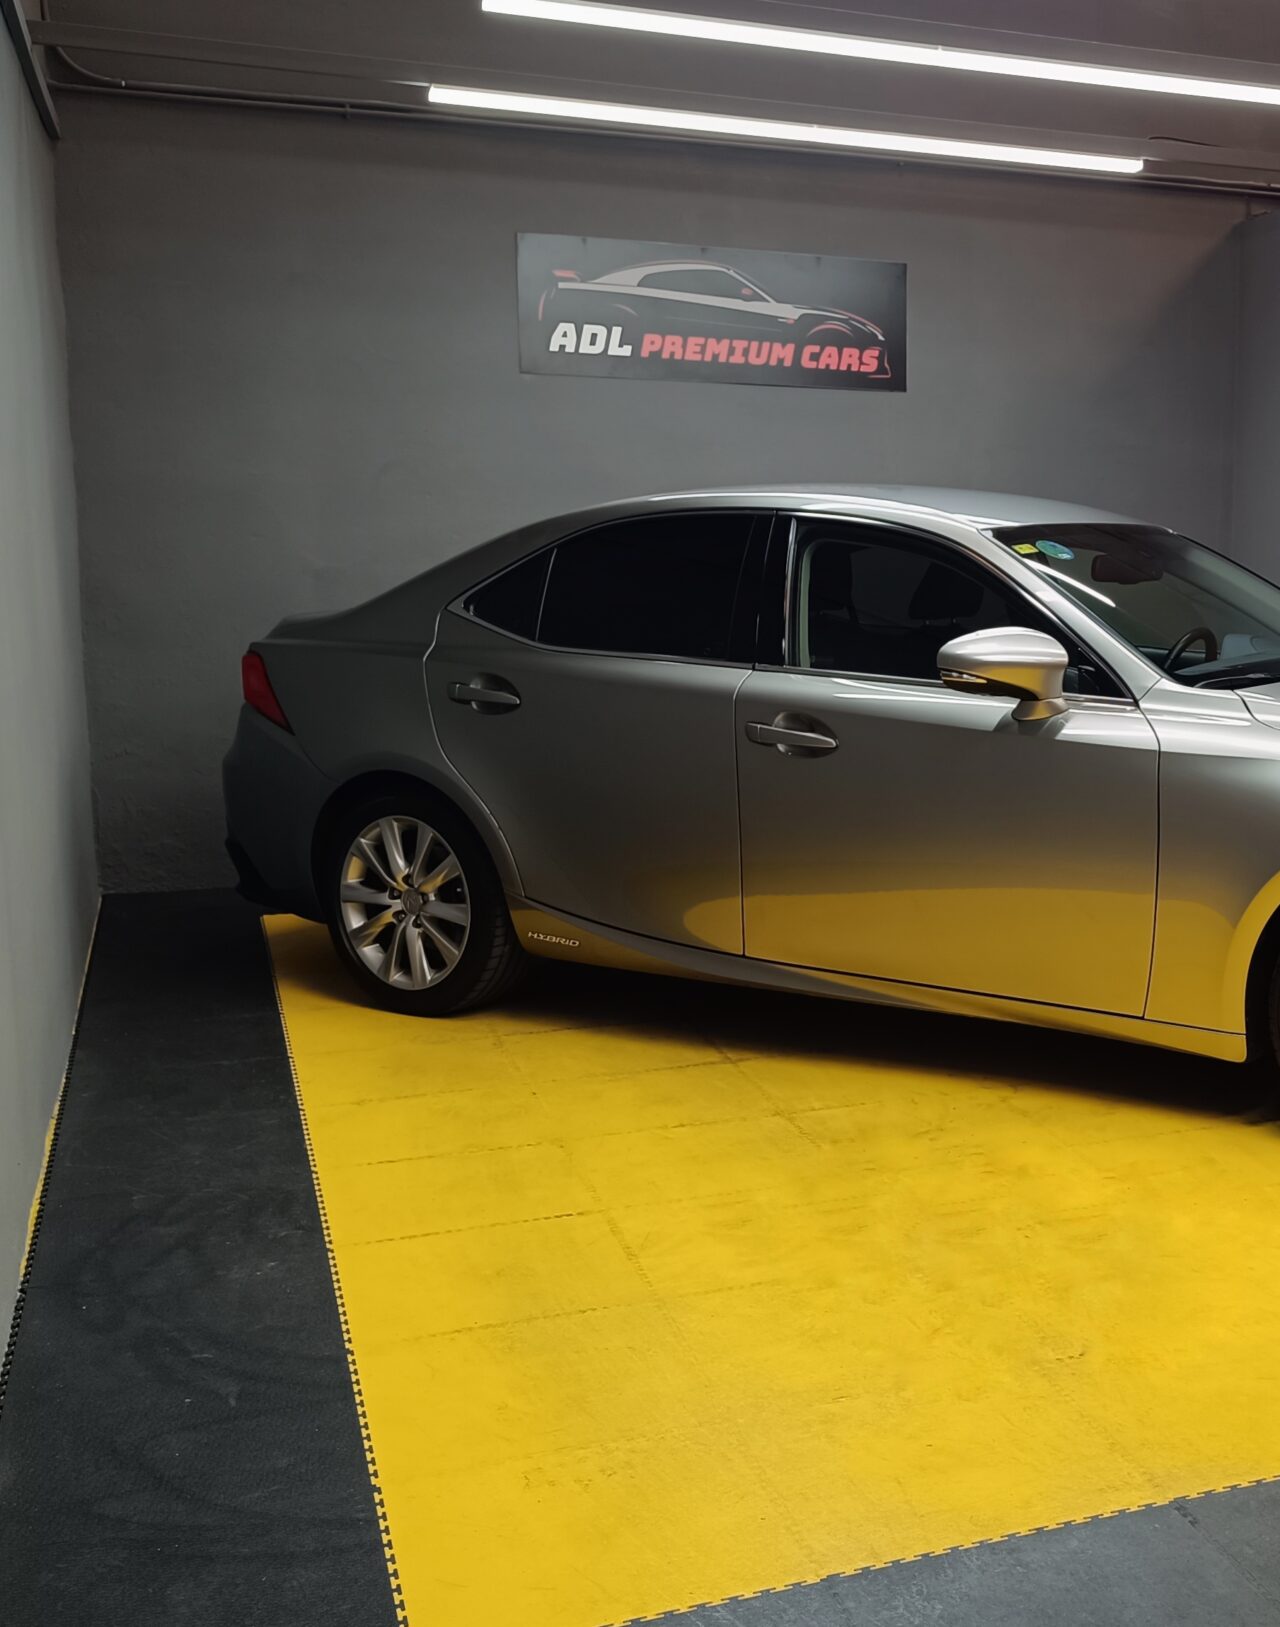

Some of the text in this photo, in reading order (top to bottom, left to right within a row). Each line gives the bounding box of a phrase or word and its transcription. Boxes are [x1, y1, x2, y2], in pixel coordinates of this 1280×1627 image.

[548, 322, 880, 373] ADL PREMIUM CARS
[527, 931, 580, 947] HYBRID
